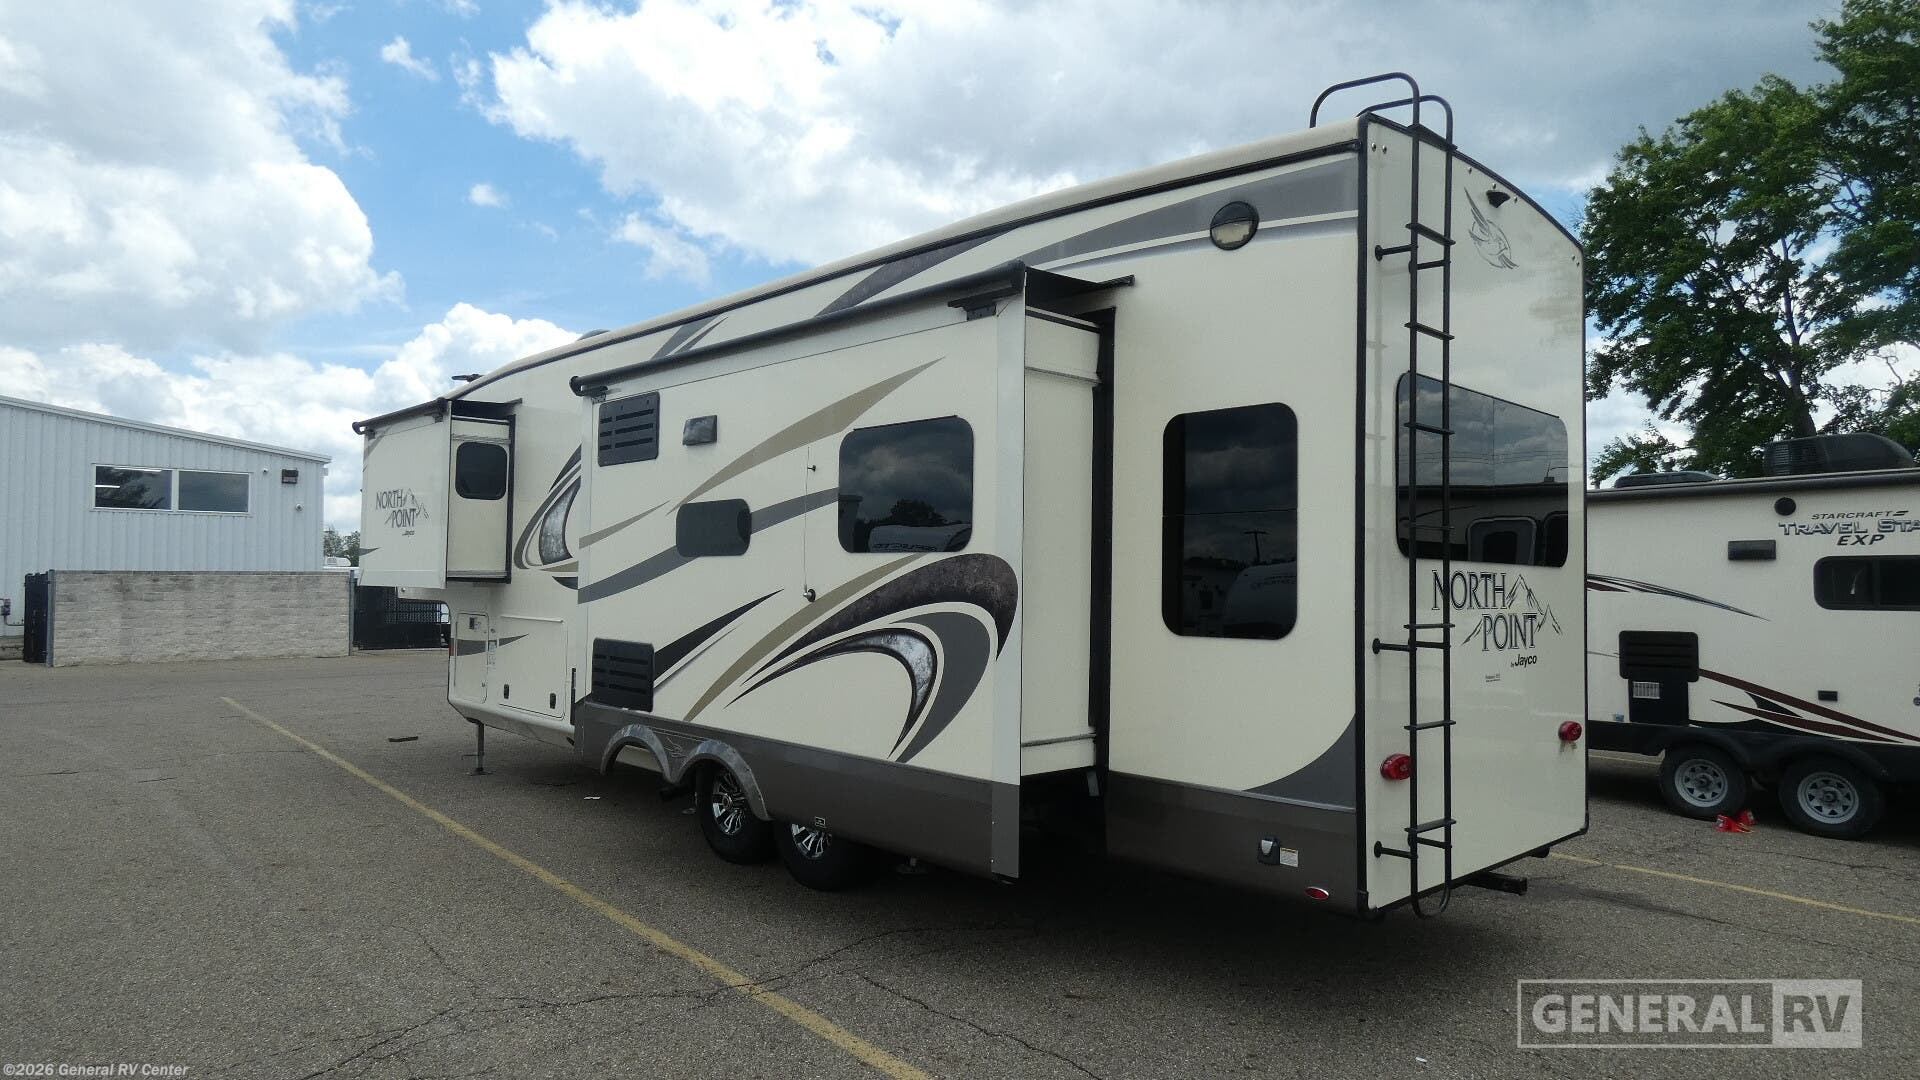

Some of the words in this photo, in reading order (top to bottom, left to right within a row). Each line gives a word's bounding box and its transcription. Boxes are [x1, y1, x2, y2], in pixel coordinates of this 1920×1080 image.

[375, 489, 404, 510] NORTH
[391, 508, 417, 528] POINT
[1811, 511, 1893, 520] STARCRAFT
[1778, 520, 1868, 536] TRAVEL
[1836, 534, 1885, 546] EXP
[1431, 569, 1507, 610] NORTH
[1481, 612, 1538, 652] POINT
[1514, 653, 1538, 668] Jayco
